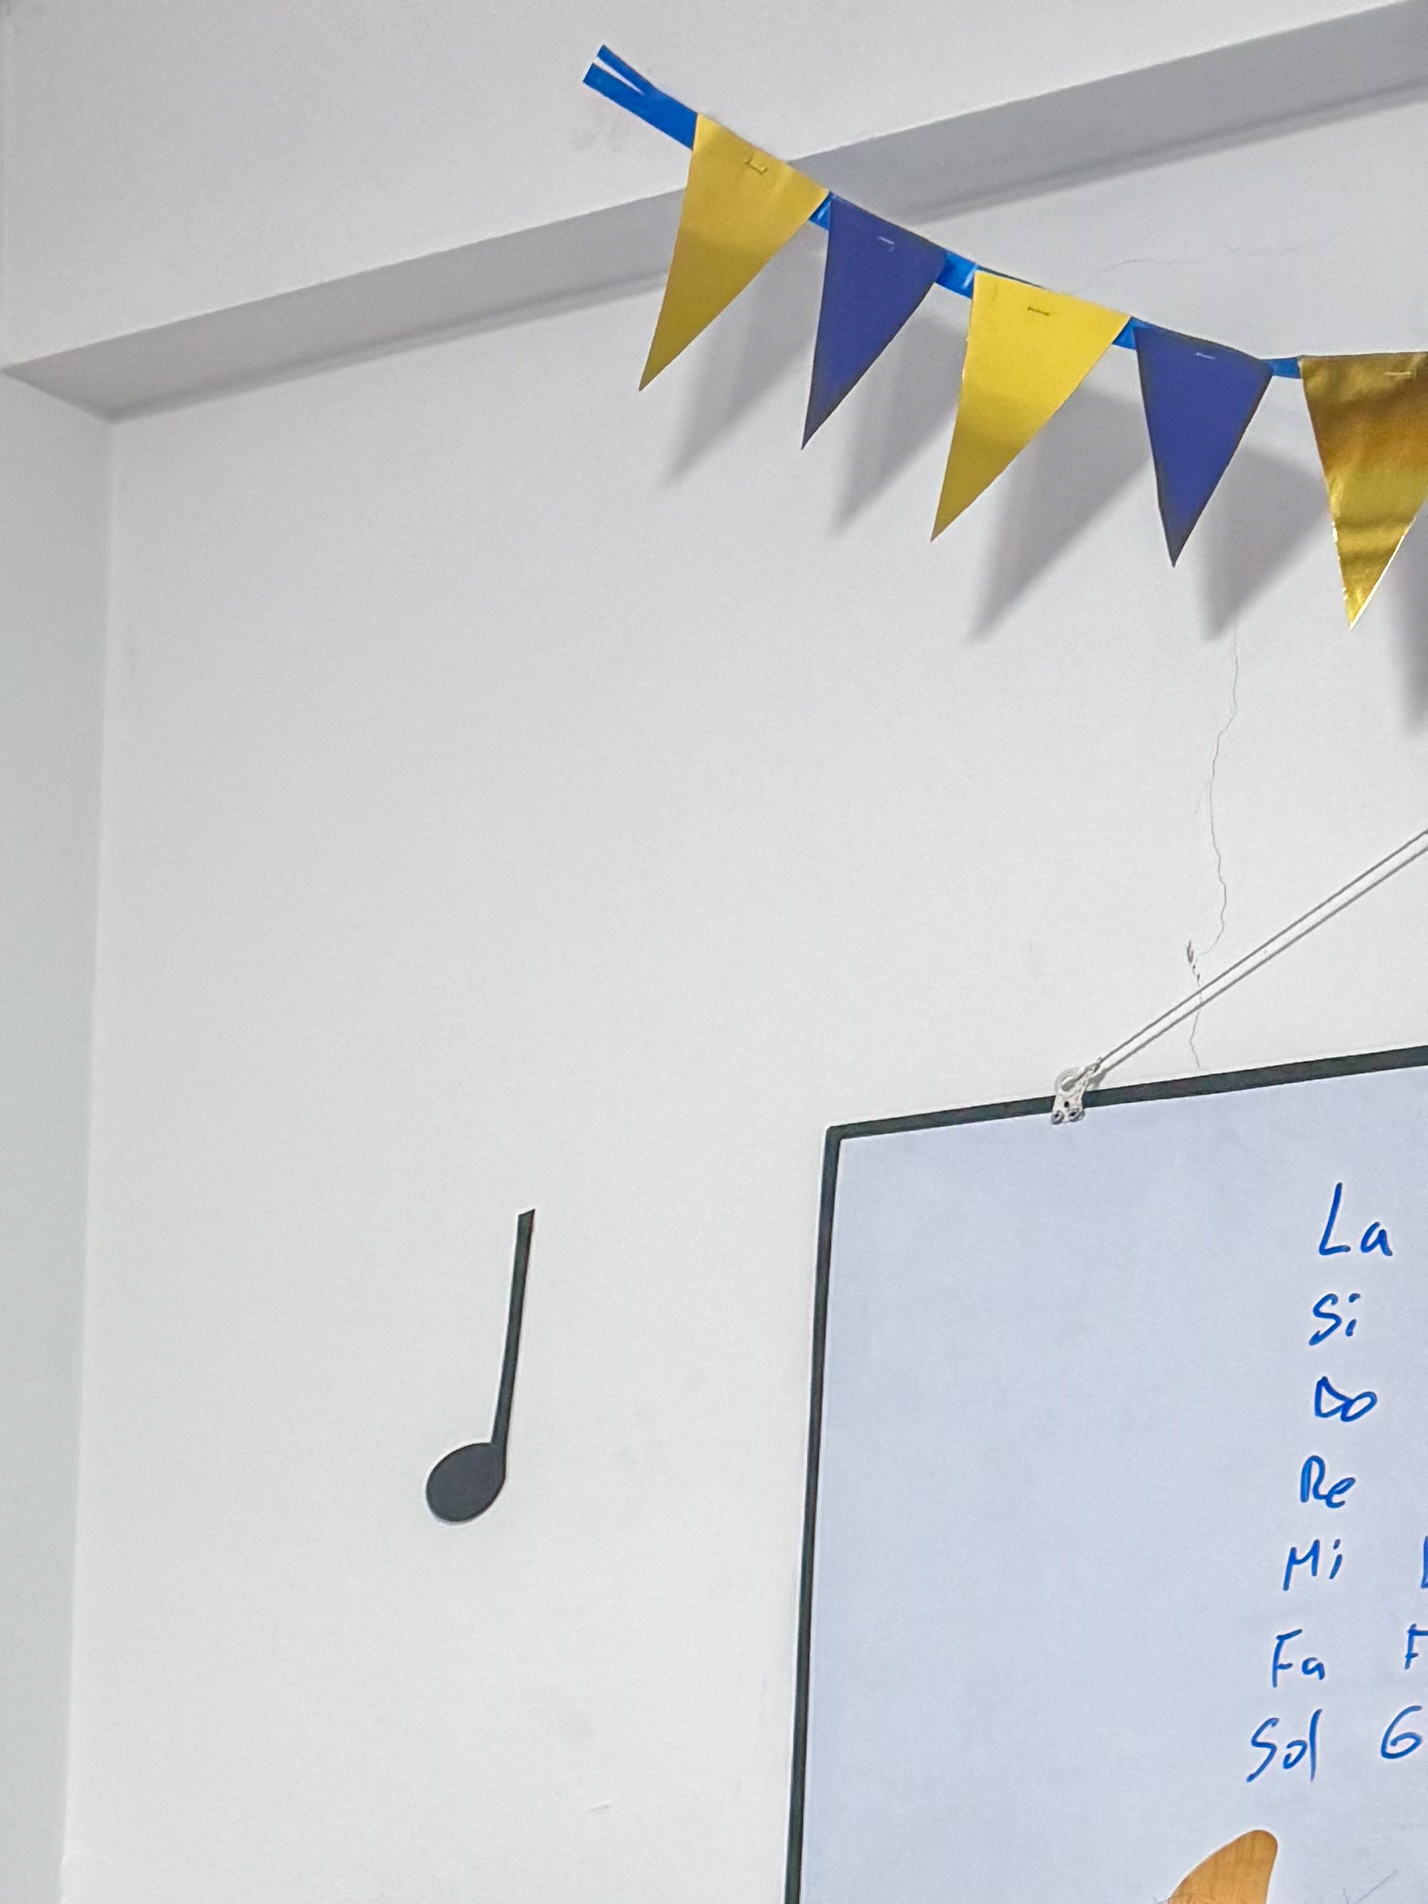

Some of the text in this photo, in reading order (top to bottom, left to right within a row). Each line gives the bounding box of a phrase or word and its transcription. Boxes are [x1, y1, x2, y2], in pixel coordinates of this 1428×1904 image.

[1318, 1182, 1393, 1256] La
[1308, 1293, 1361, 1346] Si
[1314, 1376, 1378, 1422] Do
[1300, 1455, 1356, 1508] Re
[1282, 1539, 1343, 1591] Mi
[1271, 1628, 1326, 1688] Fa
[1246, 1708, 1323, 1783] Sol
